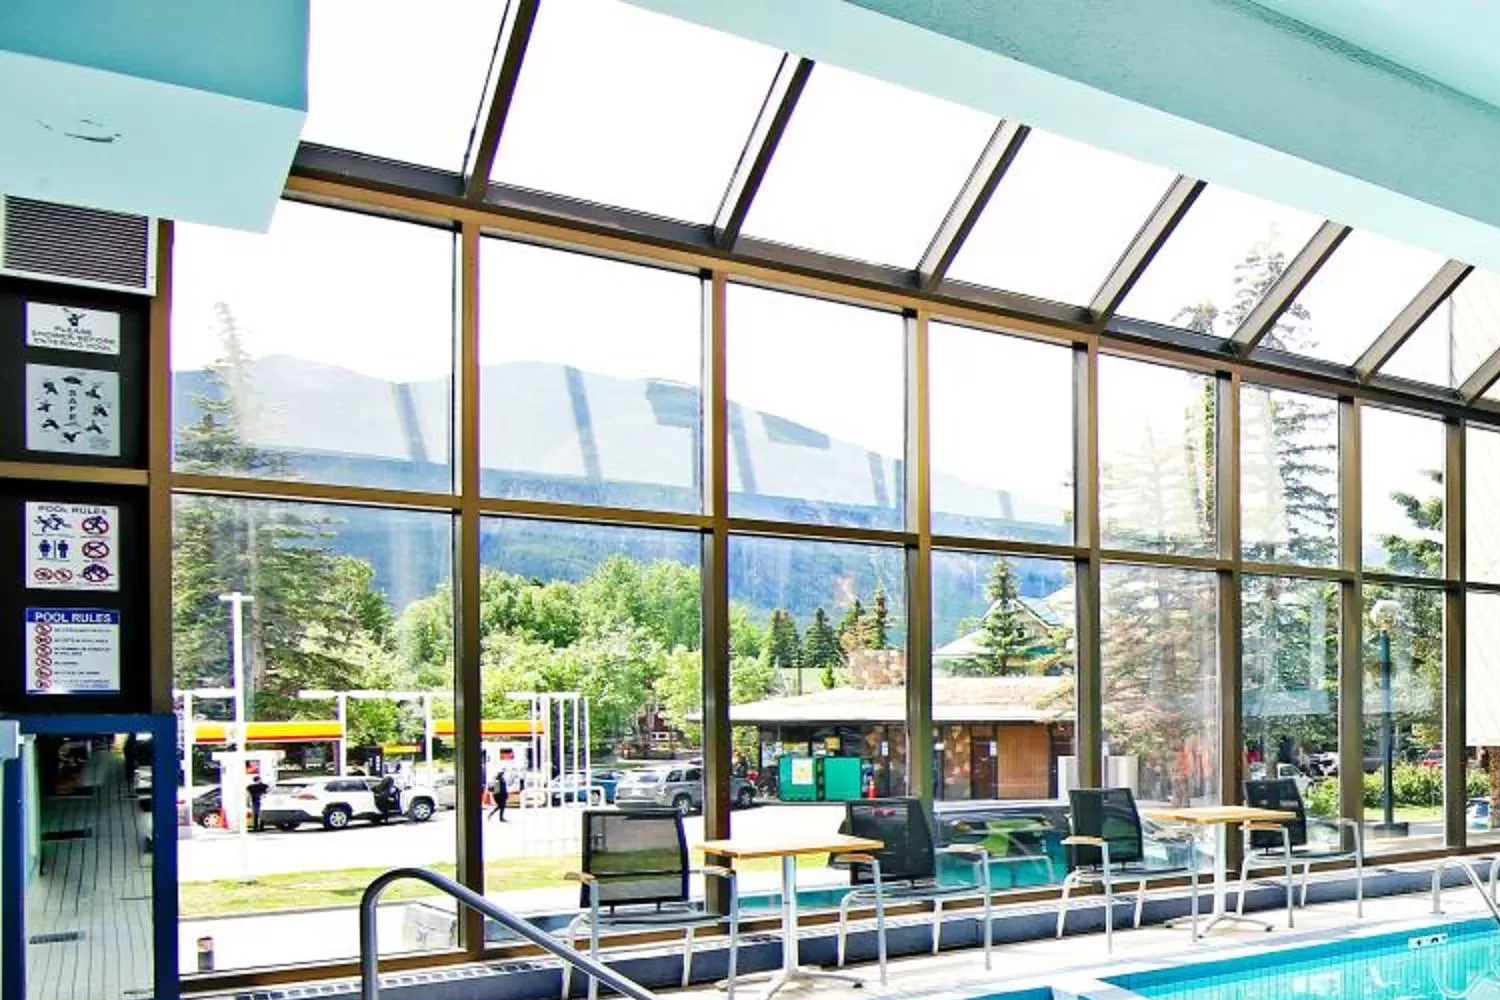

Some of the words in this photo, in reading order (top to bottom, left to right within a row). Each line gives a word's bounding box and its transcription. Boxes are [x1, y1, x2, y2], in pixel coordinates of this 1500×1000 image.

[37, 505, 67, 513] POOL
[35, 611, 69, 623] POOL
[72, 613, 112, 623] RULES
